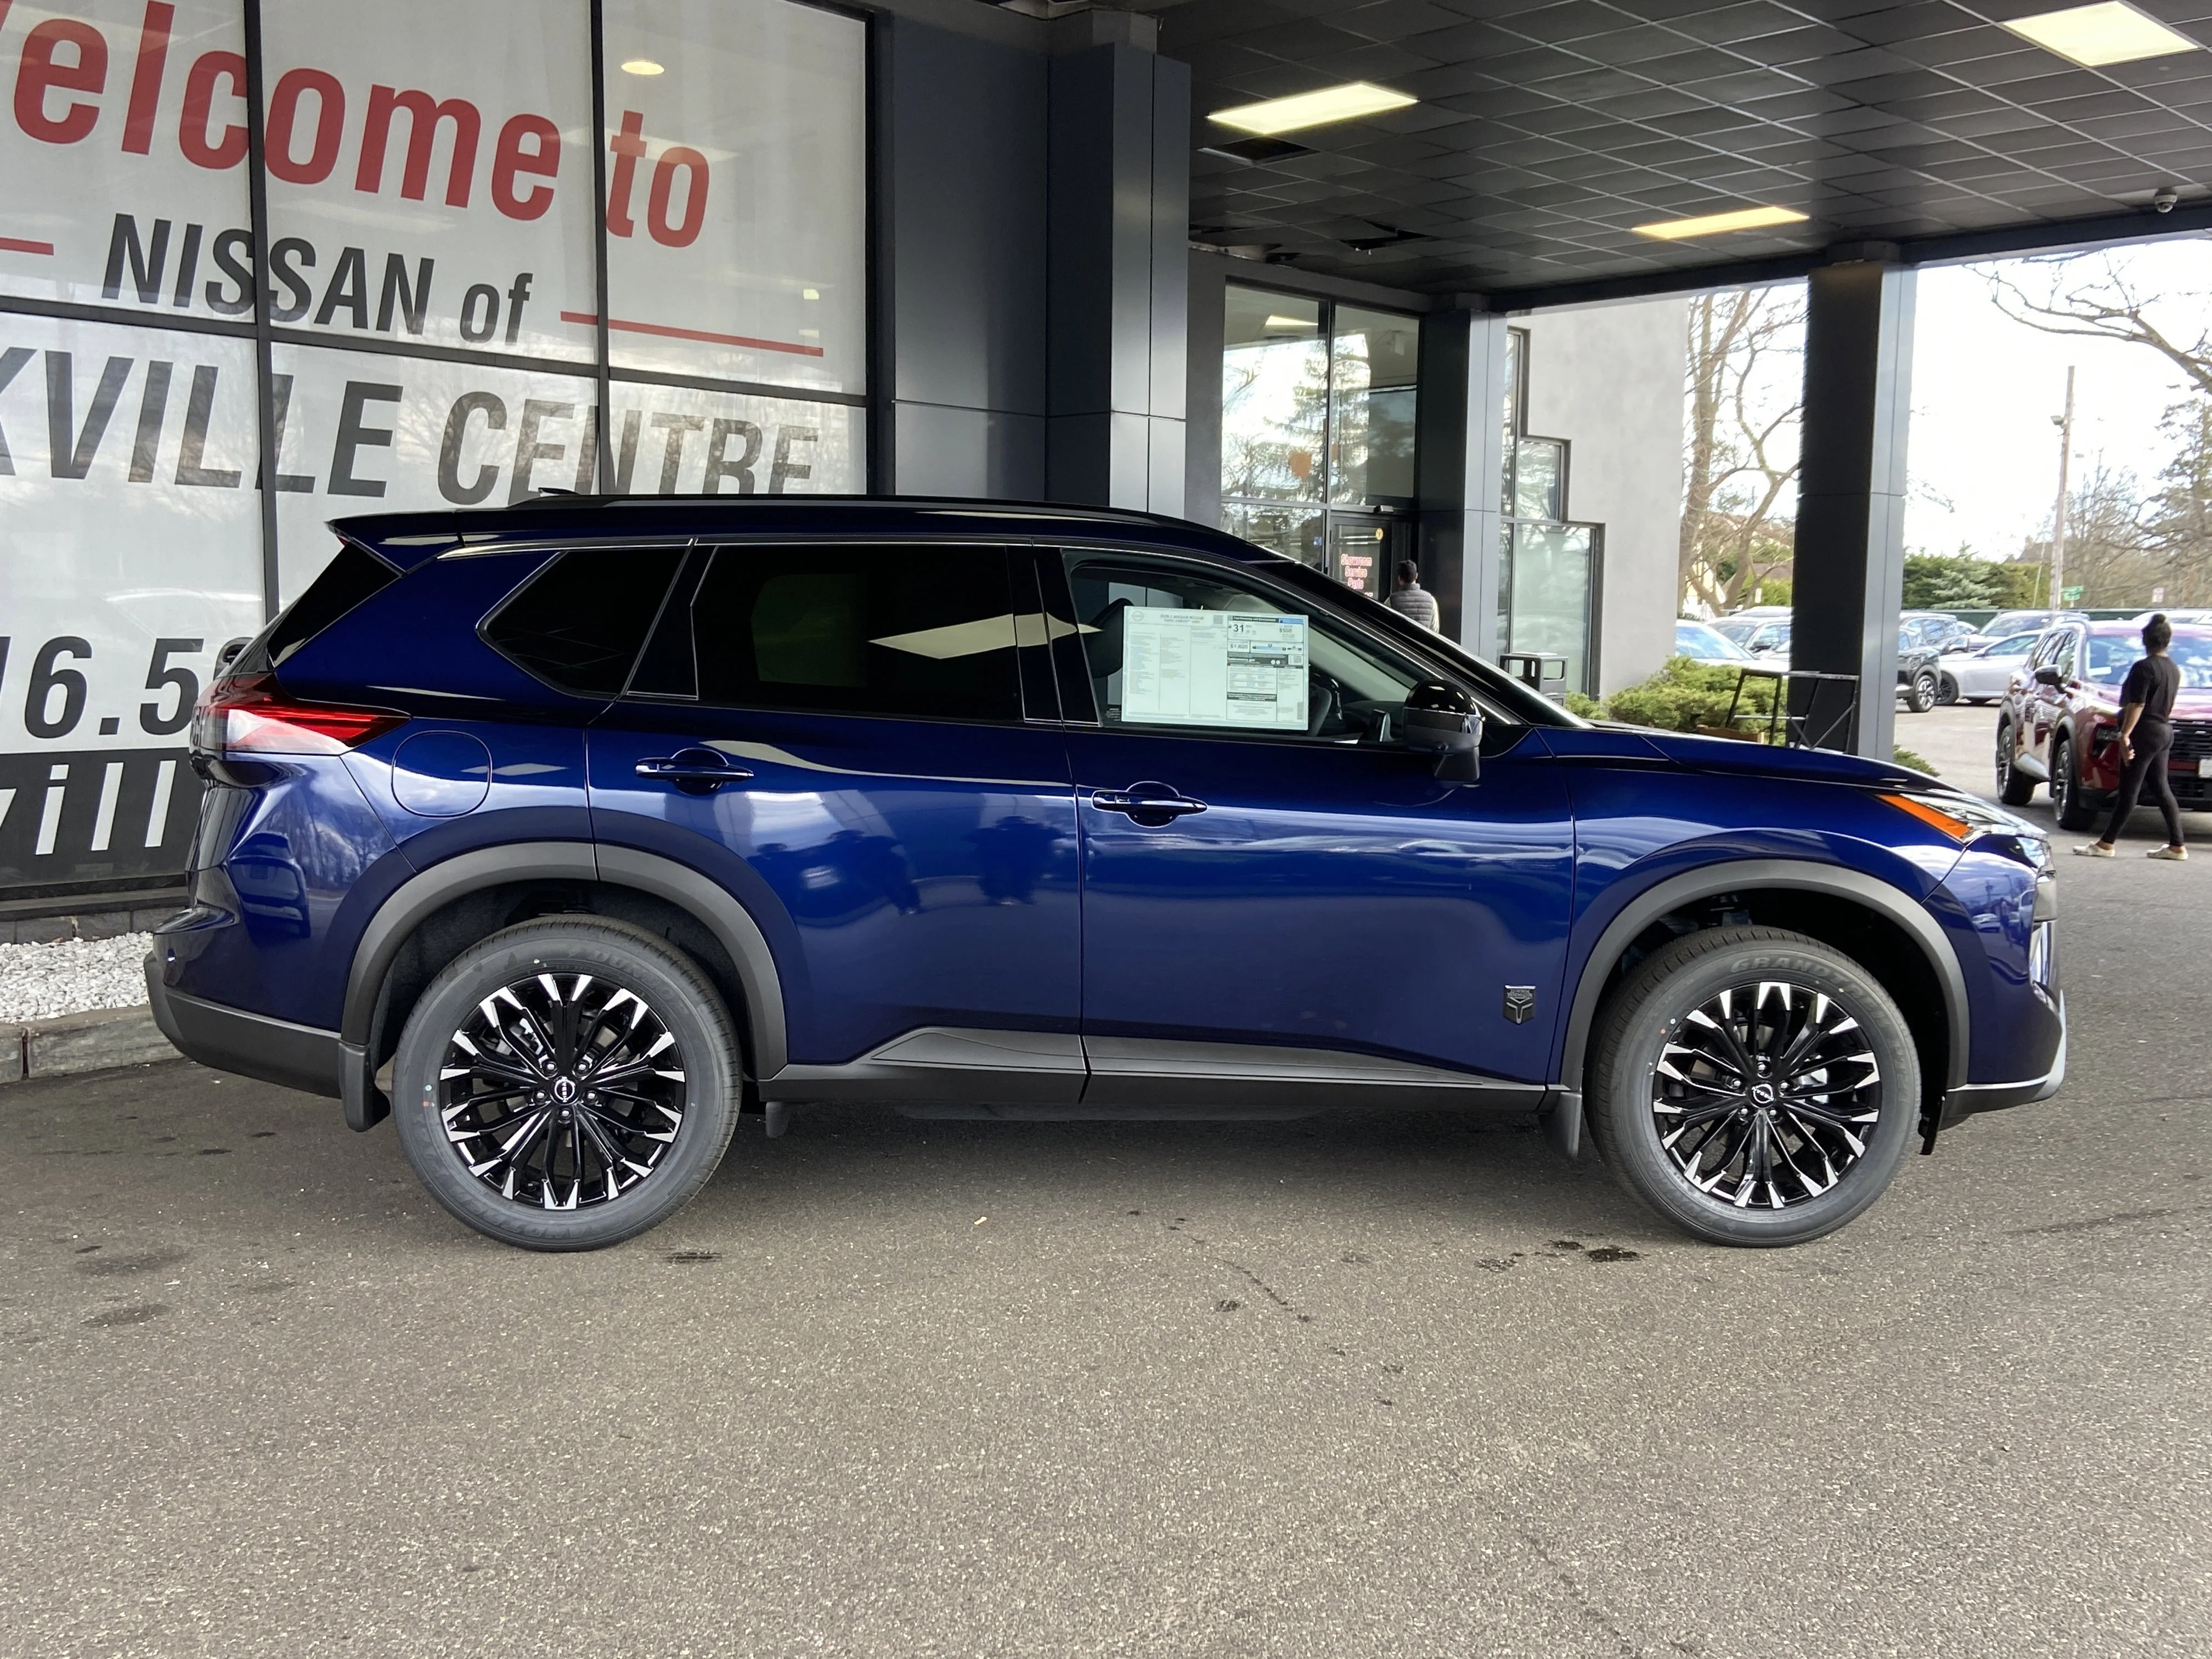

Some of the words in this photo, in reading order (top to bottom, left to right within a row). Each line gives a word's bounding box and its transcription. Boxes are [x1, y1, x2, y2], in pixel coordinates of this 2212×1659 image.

[0, 0, 561, 221] elcome
[606, 110, 710, 248] to
[101, 213, 435, 335] NISSAN
[459, 273, 534, 344] of
[438, 391, 820, 509] CENTRE
[1233, 624, 1244, 633] 31
